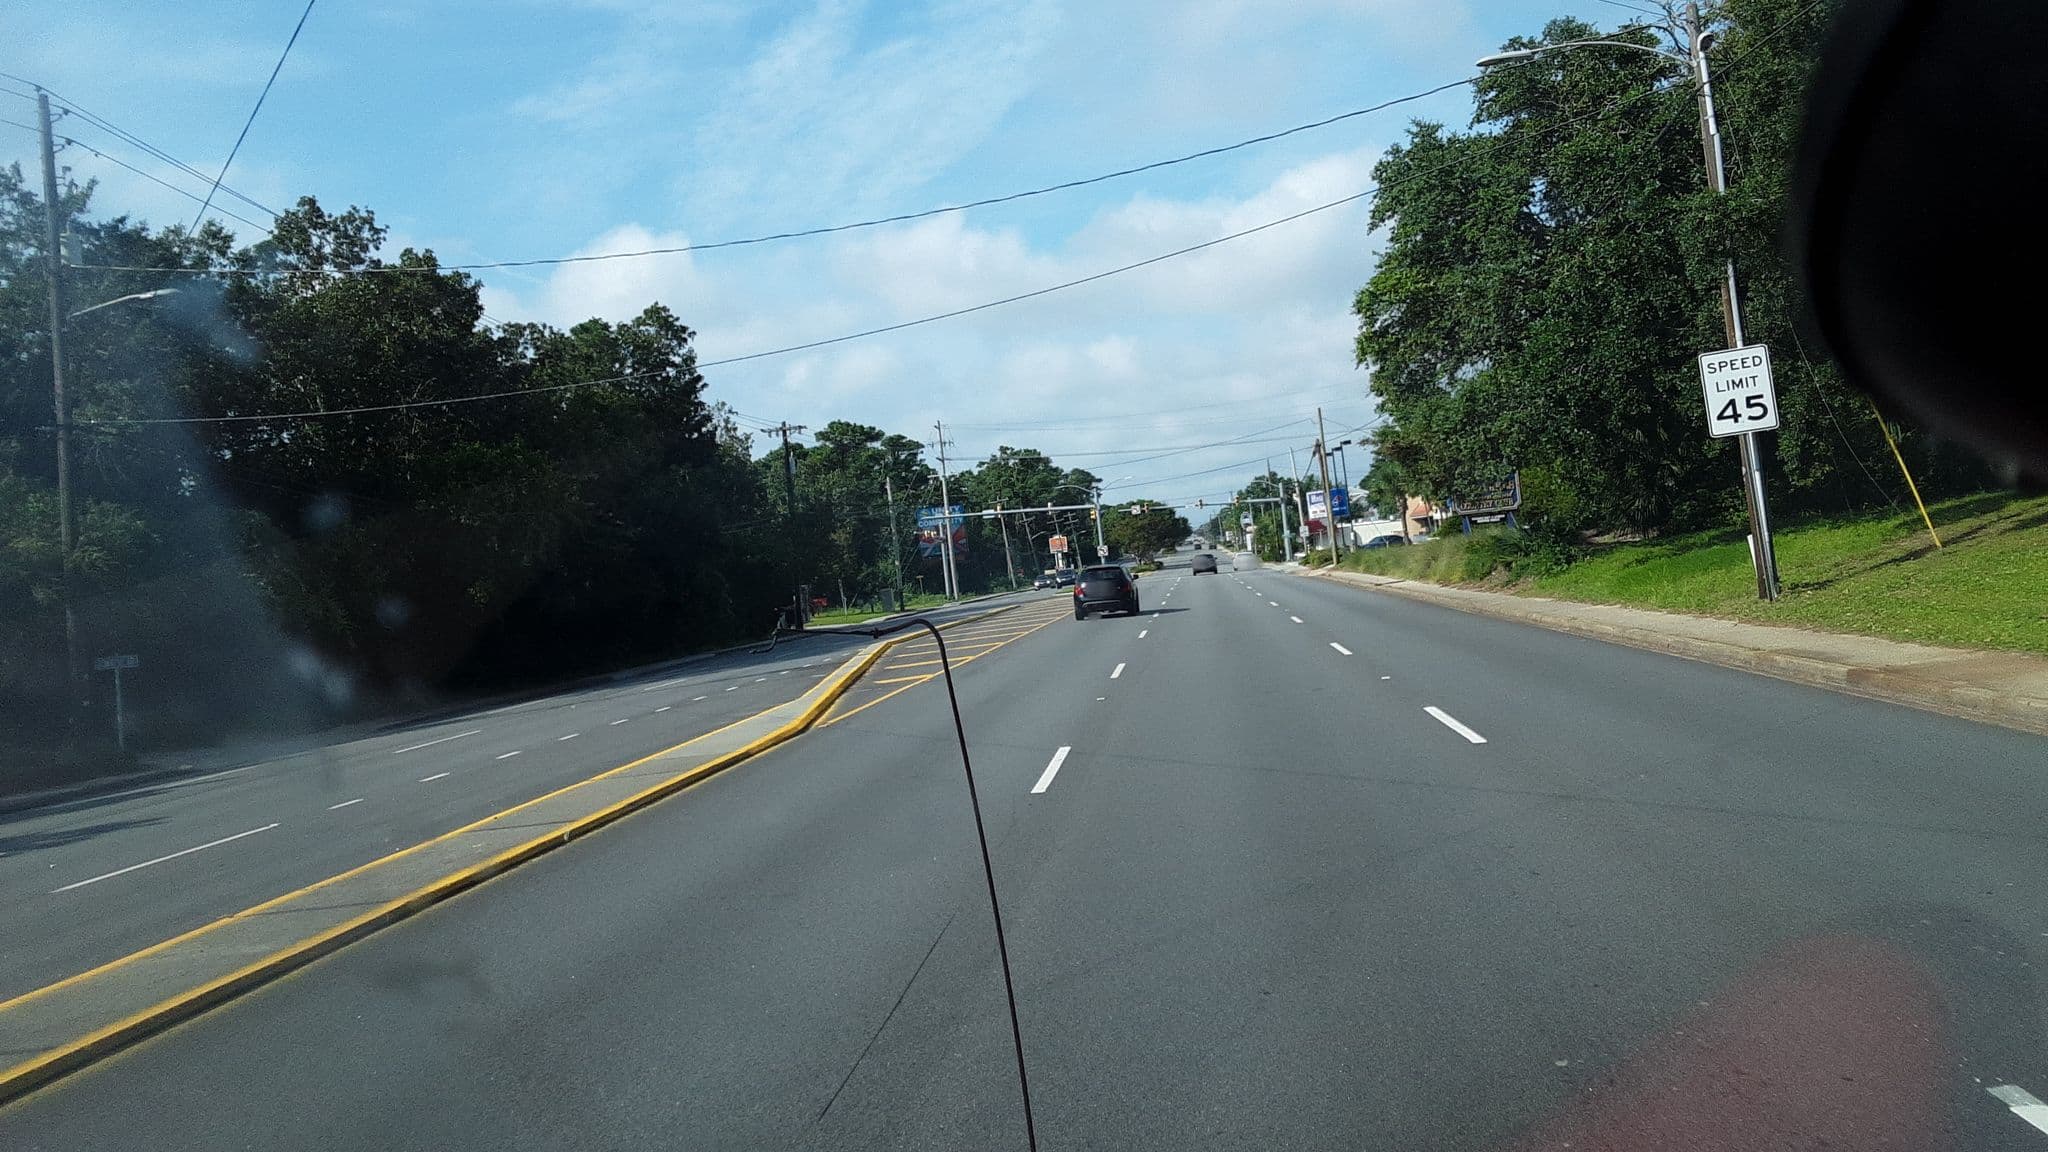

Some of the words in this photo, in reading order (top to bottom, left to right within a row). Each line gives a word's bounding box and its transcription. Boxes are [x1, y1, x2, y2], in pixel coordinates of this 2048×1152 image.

[1706, 355, 1763, 375] SPEED
[1715, 375, 1759, 393] LIMIT
[1716, 394, 1769, 424] 45
